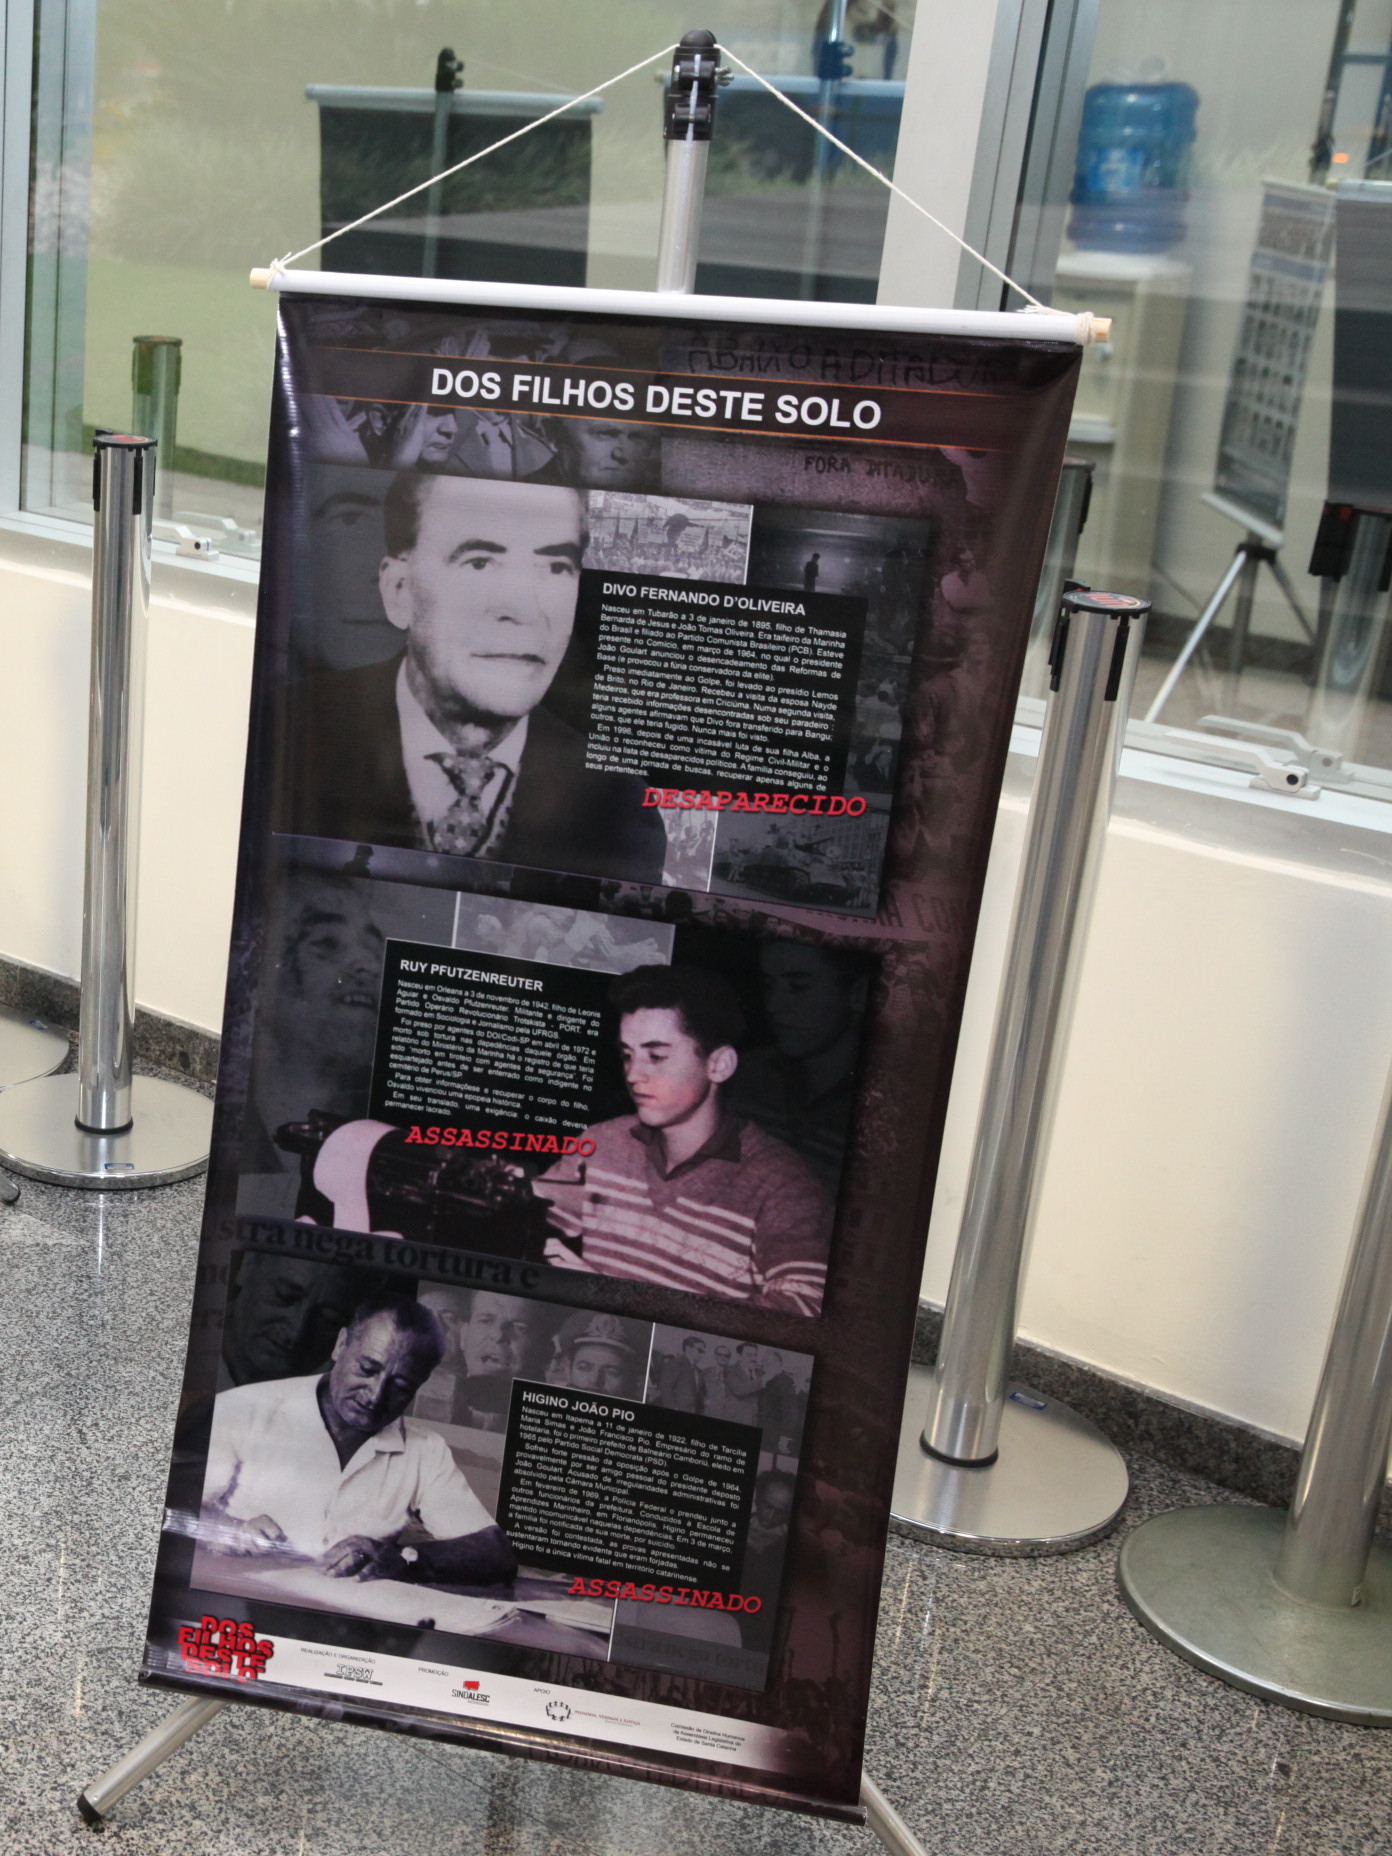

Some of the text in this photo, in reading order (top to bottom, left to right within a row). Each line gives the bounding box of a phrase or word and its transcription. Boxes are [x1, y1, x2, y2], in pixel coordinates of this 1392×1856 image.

[431, 367, 881, 430] DOS FILHOS DESTE SOLO
[602, 582, 805, 615] DIVO FERNANDO D'OLIVEIRA
[601, 603, 630, 614] Nasceu
[647, 608, 679, 619] Tubarão
[688, 613, 694, 621] 3
[696, 614, 707, 622] de
[708, 616, 736, 626] janeiro
[737, 618, 748, 627] de
[751, 620, 772, 630] 1895,
[775, 622, 792, 632] filho
[794, 625, 805, 633] de
[807, 626, 847, 638] Thamasia
[599, 623, 609, 631] do
[610, 623, 633, 634] Brasil
[641, 627, 664, 637] filiado
[665, 631, 676, 639] ao
[677, 631, 705, 642] Partido
[706, 635, 748, 647] Comunista
[749, 640, 786, 652] Brasileiro
[787, 644, 813, 655] (PCB).
[816, 647, 844, 659] Esteve
[597, 642, 616, 652] João
[619, 644, 647, 655] Goulart
[650, 650, 685, 660] anunciou
[696, 654, 767, 670] desencadeamento
[770, 663, 786, 672] das
[788, 664, 827, 677] Reformas
[830, 670, 841, 679] de
[641, 787, 867, 816] DESAPARECIDO
[399, 958, 543, 992] RUY PFUTZENREUTER
[395, 996, 420, 1007] Partido
[424, 1001, 454, 1013] Operário
[458, 1006, 508, 1021] Revolucionário
[512, 1015, 546, 1028] Trotskista
[558, 1022, 581, 1033] PORT,
[586, 1028, 599, 1036] era
[404, 1124, 596, 1156] ASSASSINADO
[522, 1390, 634, 1422] HIGINO JOÃO PIO
[509, 1493, 549, 1507] Aprendizes
[553, 1501, 592, 1515] Marinheiro,
[611, 1512, 657, 1528] Florianópolis,
[662, 1523, 686, 1534] Higino
[688, 1530, 734, 1544] permaneceu
[567, 1576, 762, 1614] ASSASSINADO
[201, 1615, 255, 1638] DOS
[451, 1688, 490, 1703] SINDALESC
